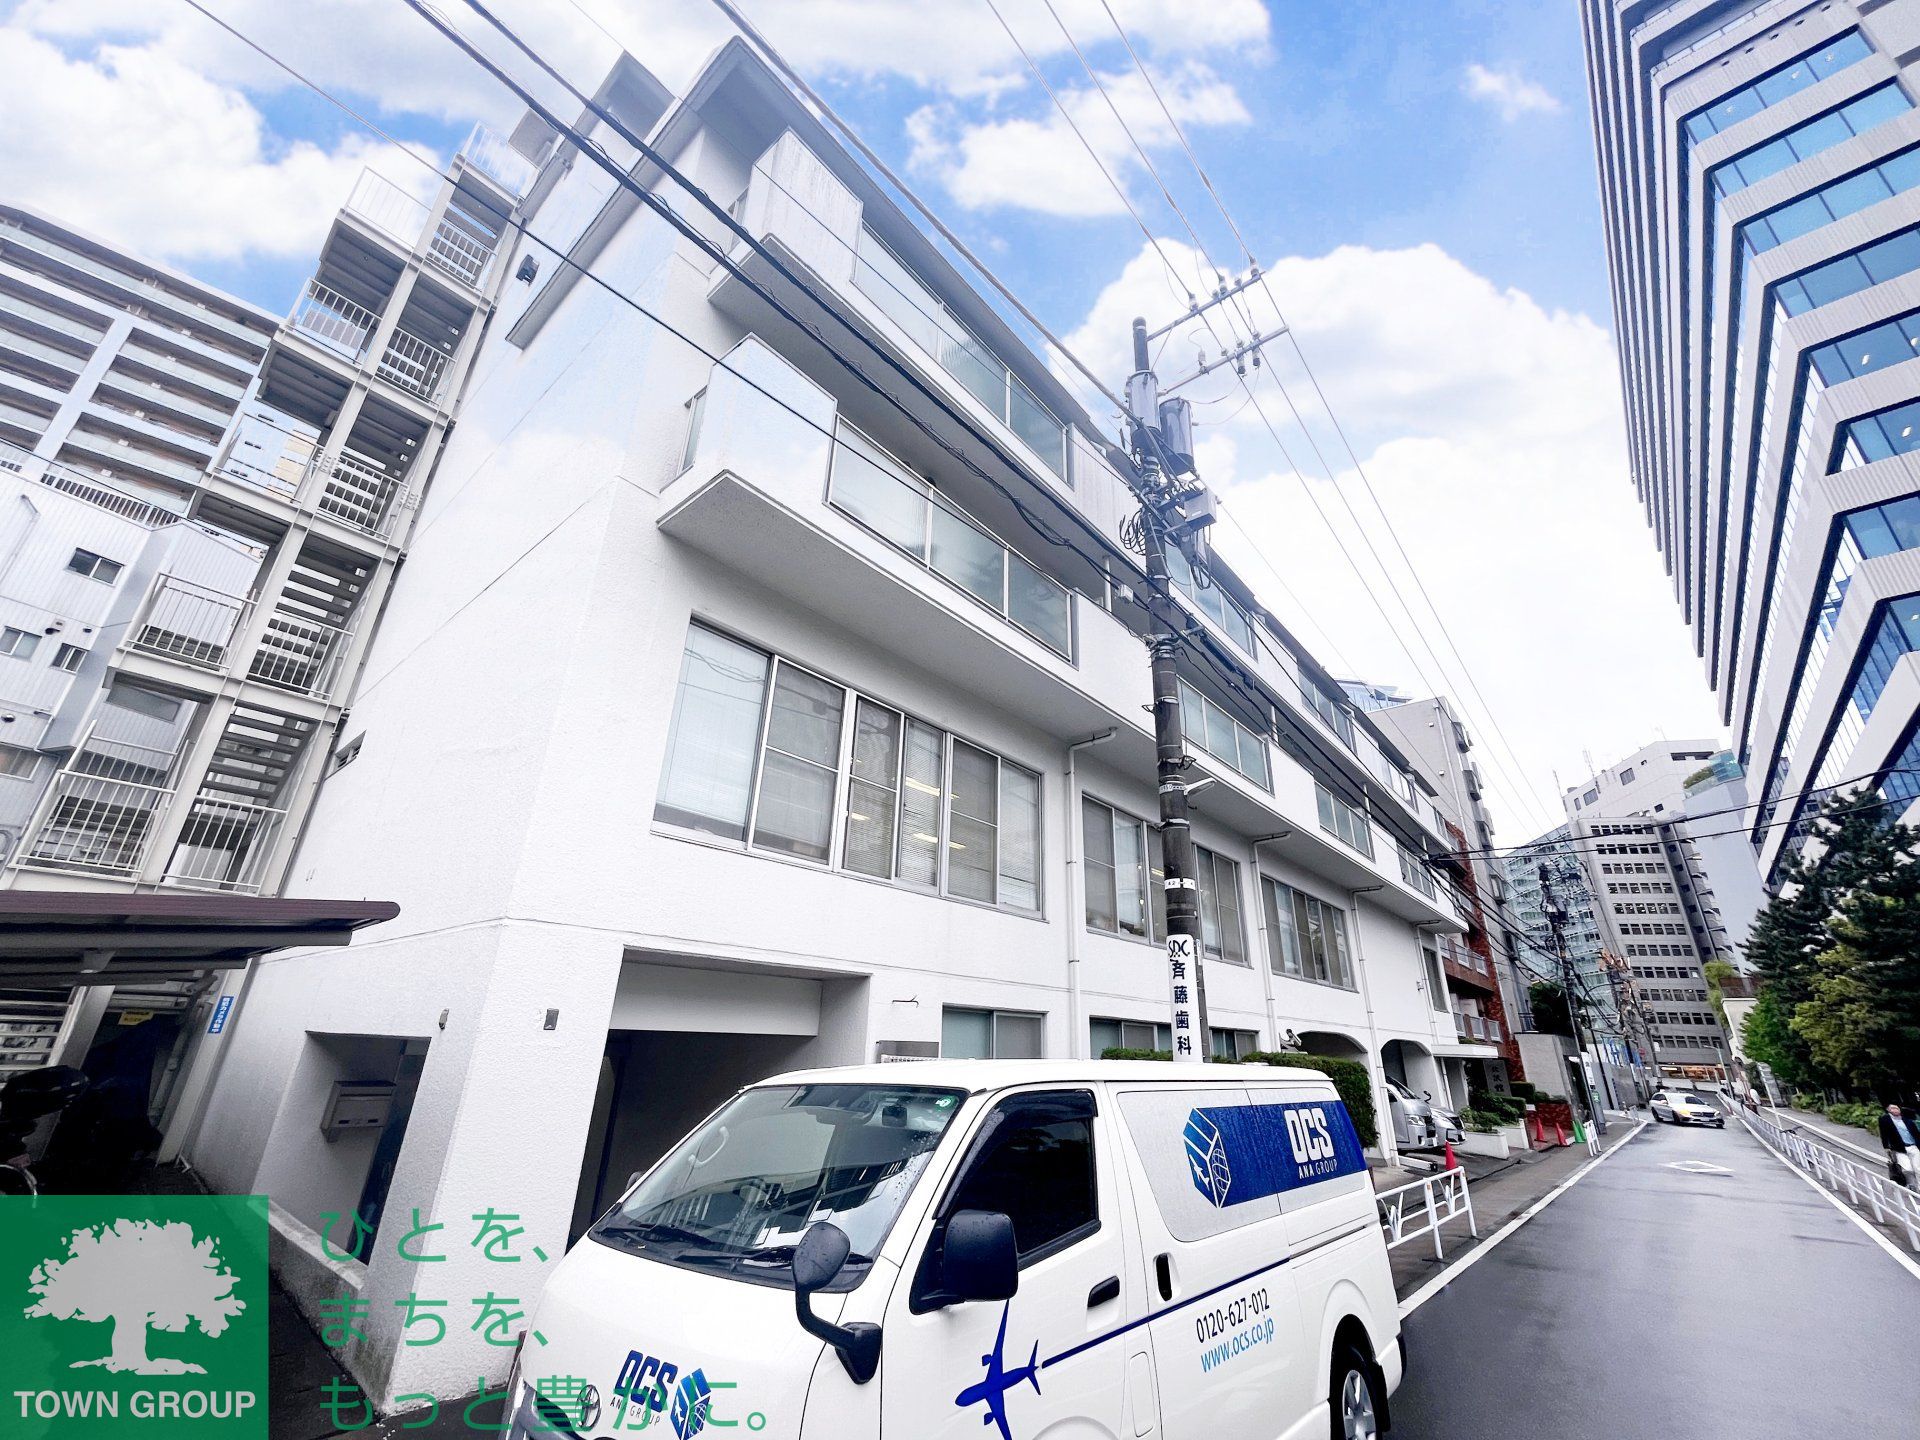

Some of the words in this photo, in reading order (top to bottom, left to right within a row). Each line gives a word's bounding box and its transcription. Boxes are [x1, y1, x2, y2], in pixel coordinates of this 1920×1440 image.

[1283, 1107, 1335, 1164] OCS
[1298, 1163, 1315, 1180] ANA
[1315, 1158, 1338, 1176] GROUP
[1196, 1287, 1270, 1344] 0120-627-012
[1200, 1315, 1275, 1373] www.ocs.co.jp
[614, 1349, 679, 1413] OCS
